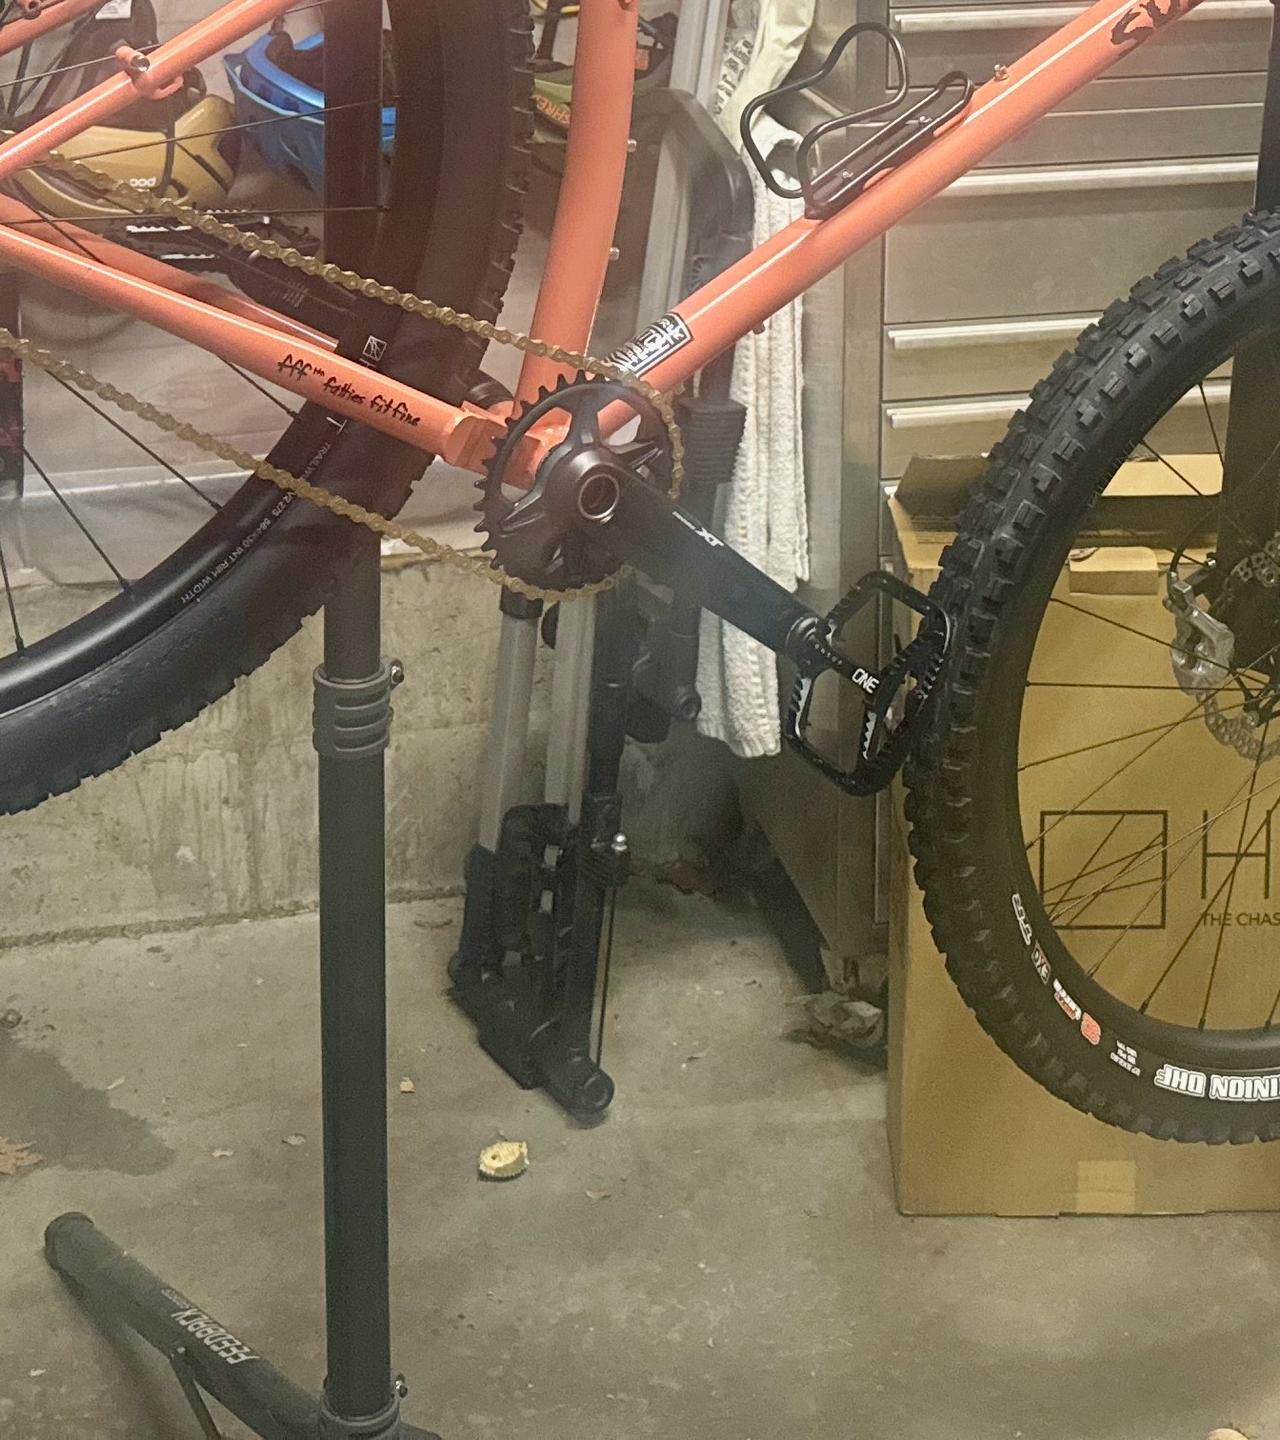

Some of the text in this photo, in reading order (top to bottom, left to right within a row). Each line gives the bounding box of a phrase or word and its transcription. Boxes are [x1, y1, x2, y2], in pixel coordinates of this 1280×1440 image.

[323, 375, 366, 405] fatties
[369, 394, 394, 415] fit
[391, 401, 421, 427] fine
[851, 667, 880, 694] ONE
[1201, 911, 1232, 927] THE
[1153, 1063, 1207, 1097] DHF
[170, 1308, 262, 1367] FEEDBACK
